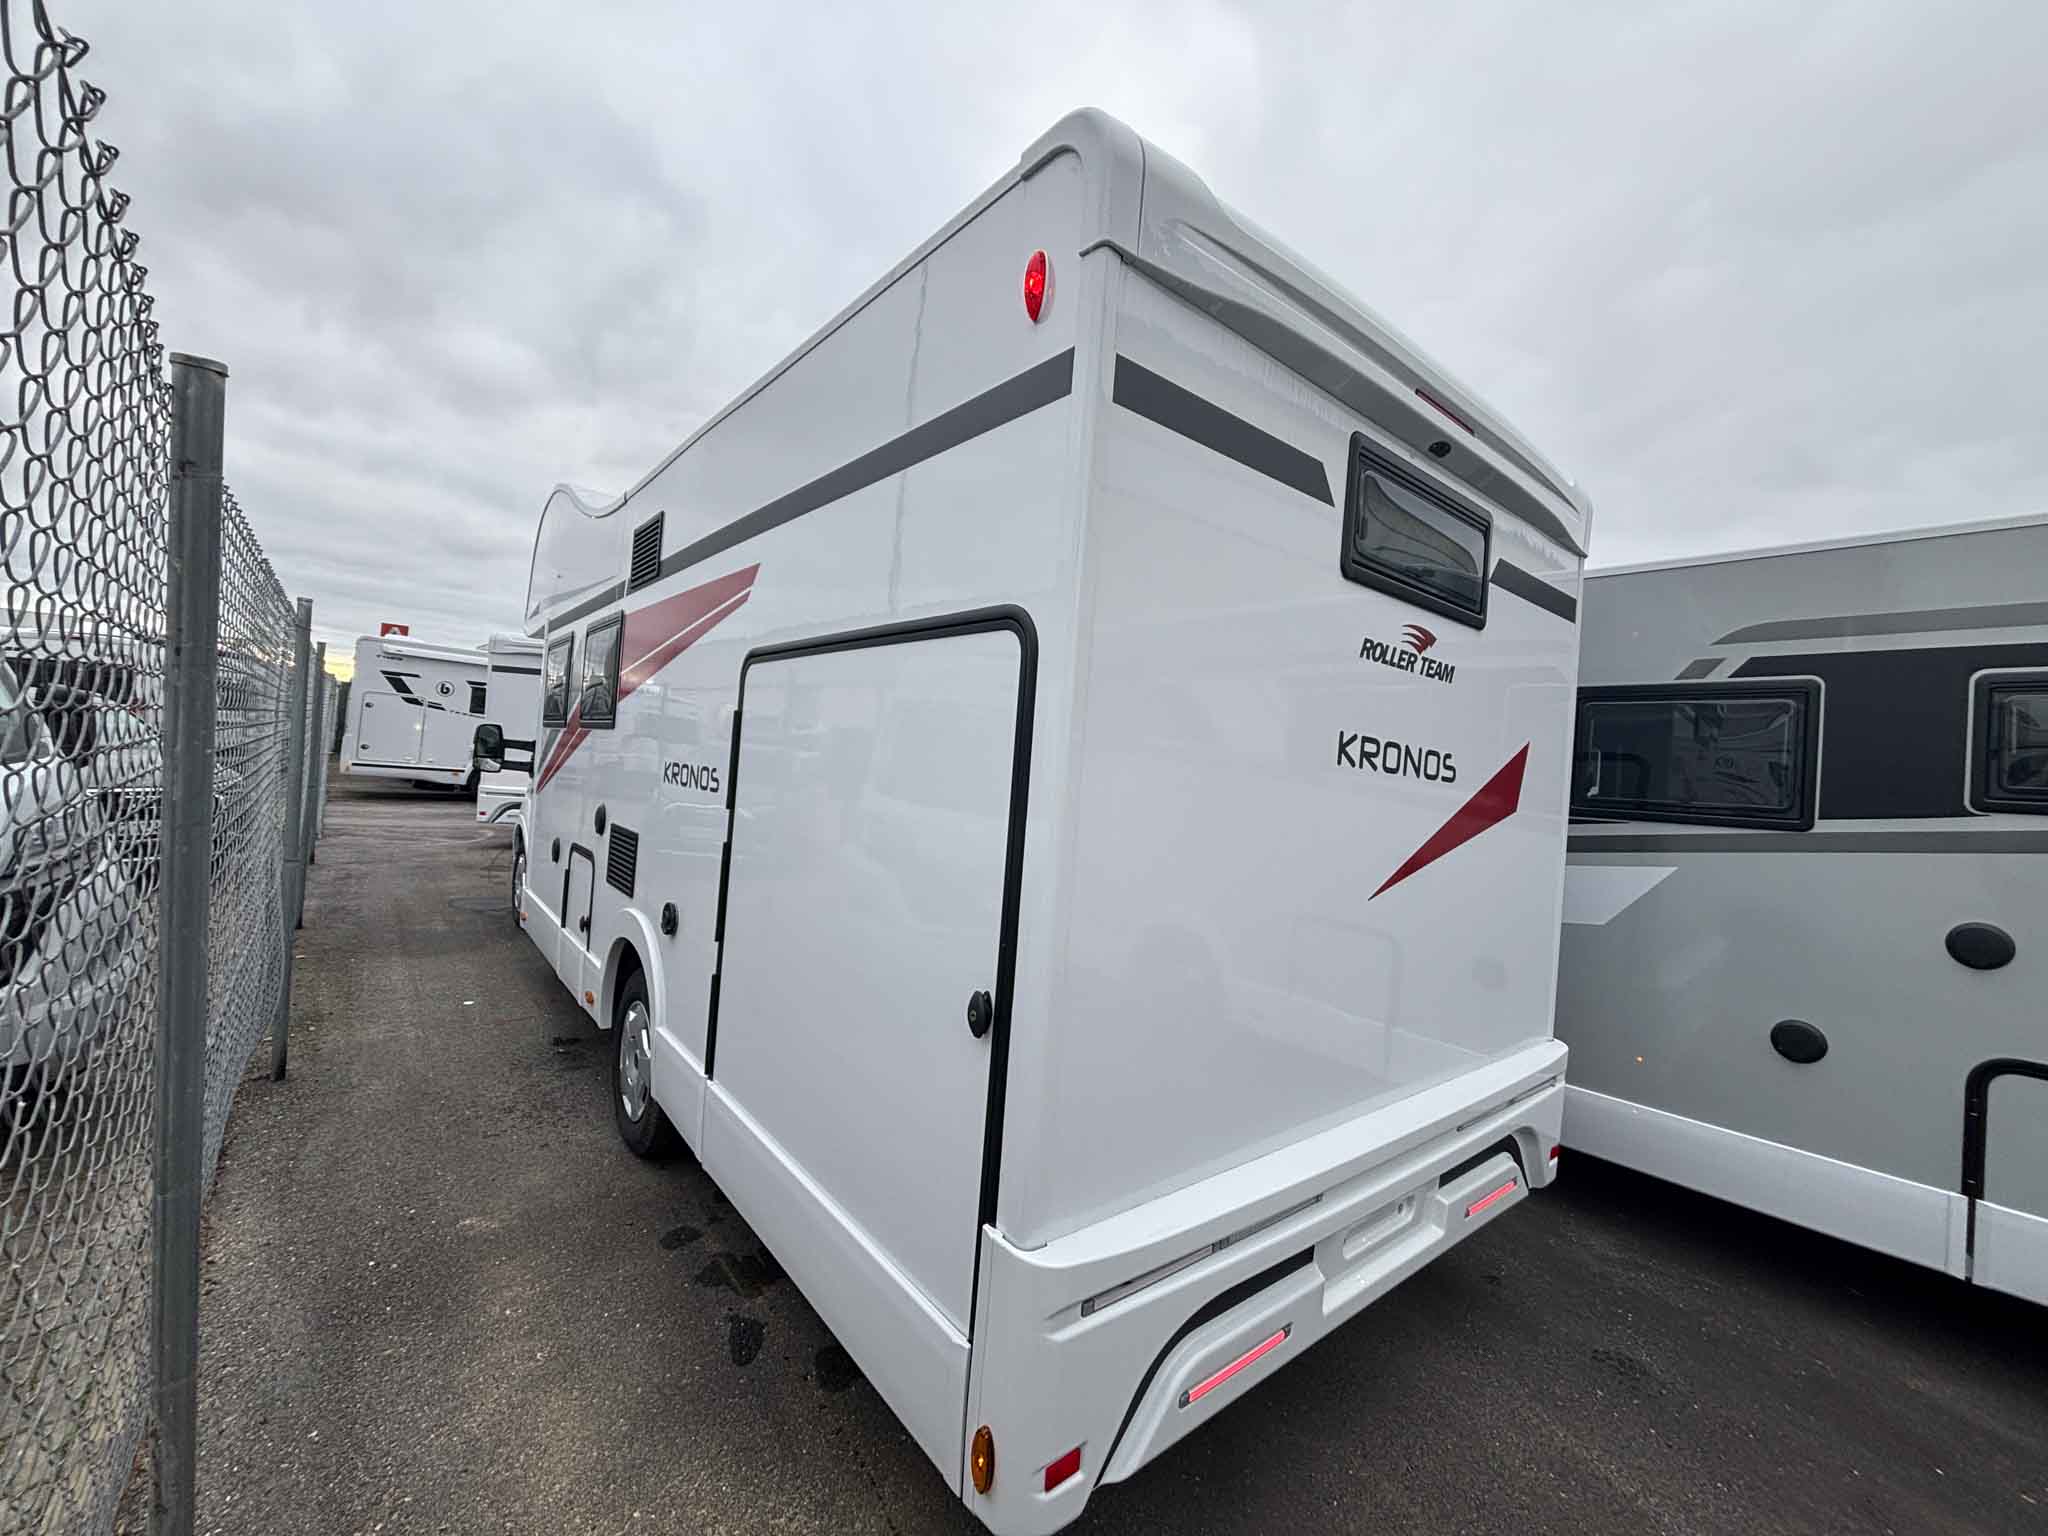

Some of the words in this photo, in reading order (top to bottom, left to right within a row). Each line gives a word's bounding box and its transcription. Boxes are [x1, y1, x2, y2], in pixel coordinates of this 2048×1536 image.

[1359, 637, 1418, 673] ROLLER
[1419, 655, 1456, 684] TEAM
[663, 761, 720, 793] KRONOS
[1336, 730, 1457, 783] KRONOS
